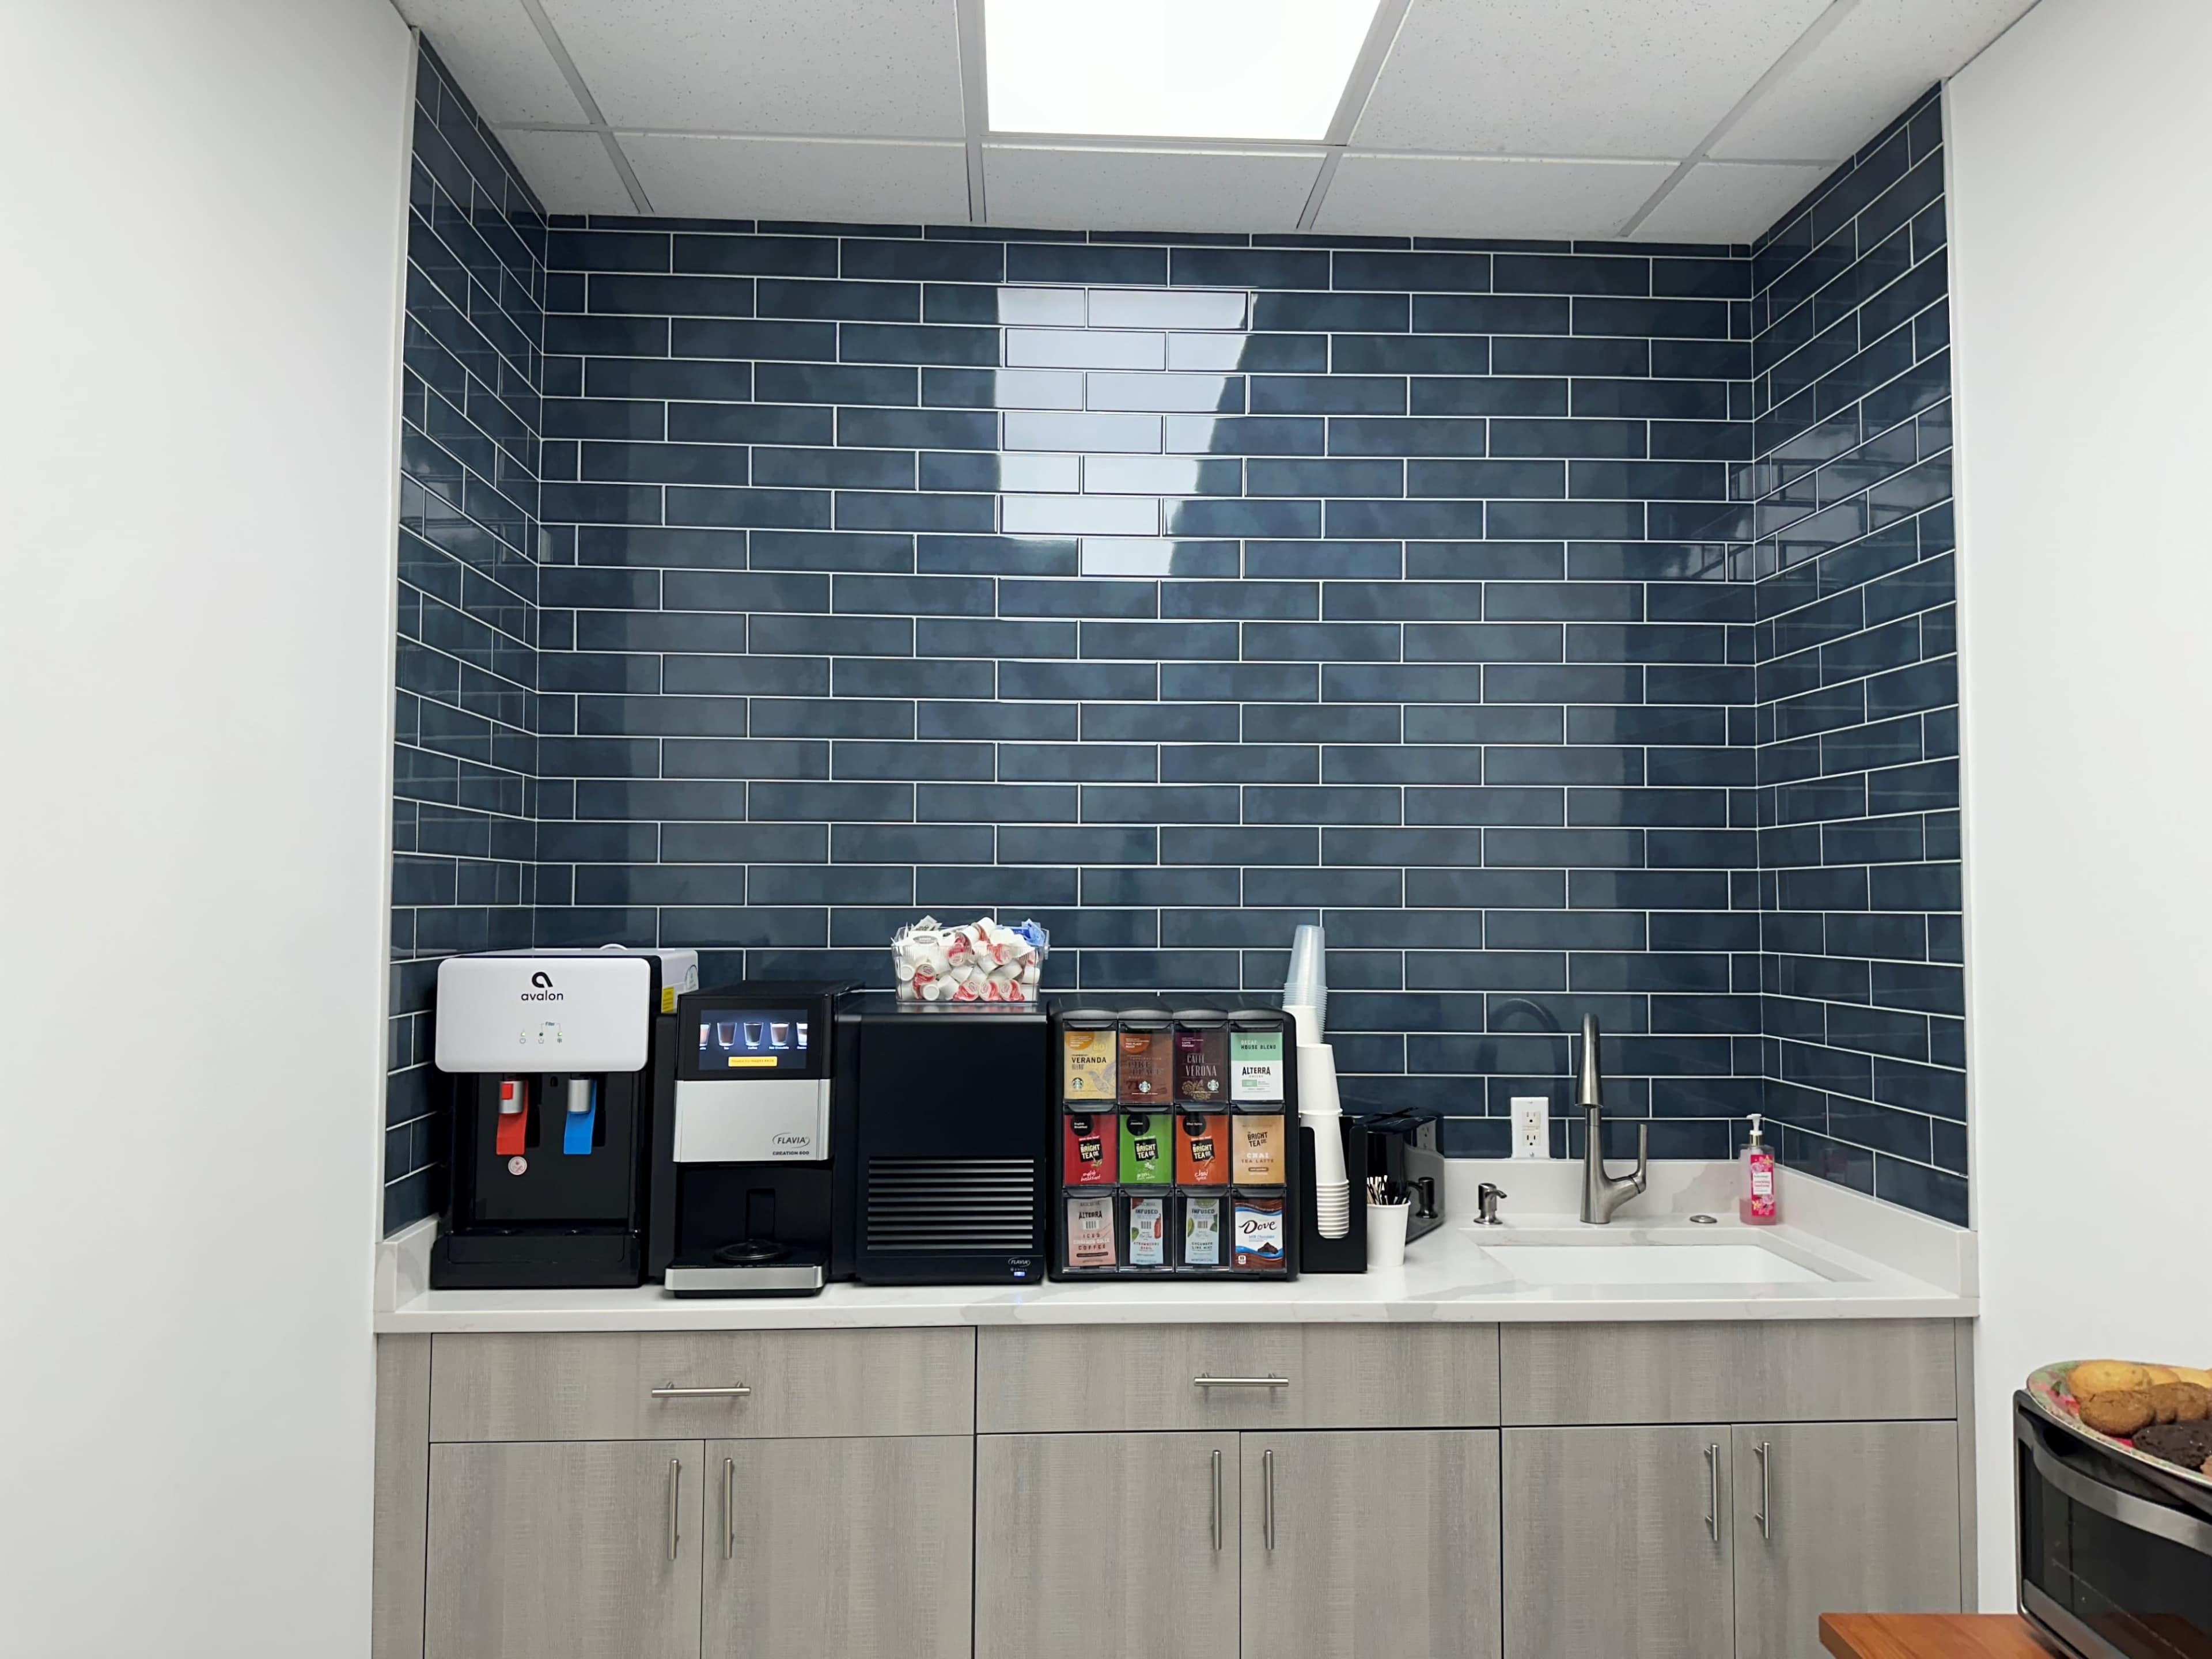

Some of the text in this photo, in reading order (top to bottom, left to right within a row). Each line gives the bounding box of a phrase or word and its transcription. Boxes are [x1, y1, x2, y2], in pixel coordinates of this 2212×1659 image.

[521, 990, 563, 1001] avalon
[1185, 1065, 1217, 1076] VERONA
[1242, 1067, 1271, 1075] ALTERRA
[1248, 1132, 1268, 1141] BRIGHT
[1080, 1144, 1100, 1153] BRIGHT
[1136, 1144, 1156, 1152] BRIGHT
[1192, 1145, 1212, 1153] BRIGHT
[1079, 1211, 1103, 1219] ALTERRA
